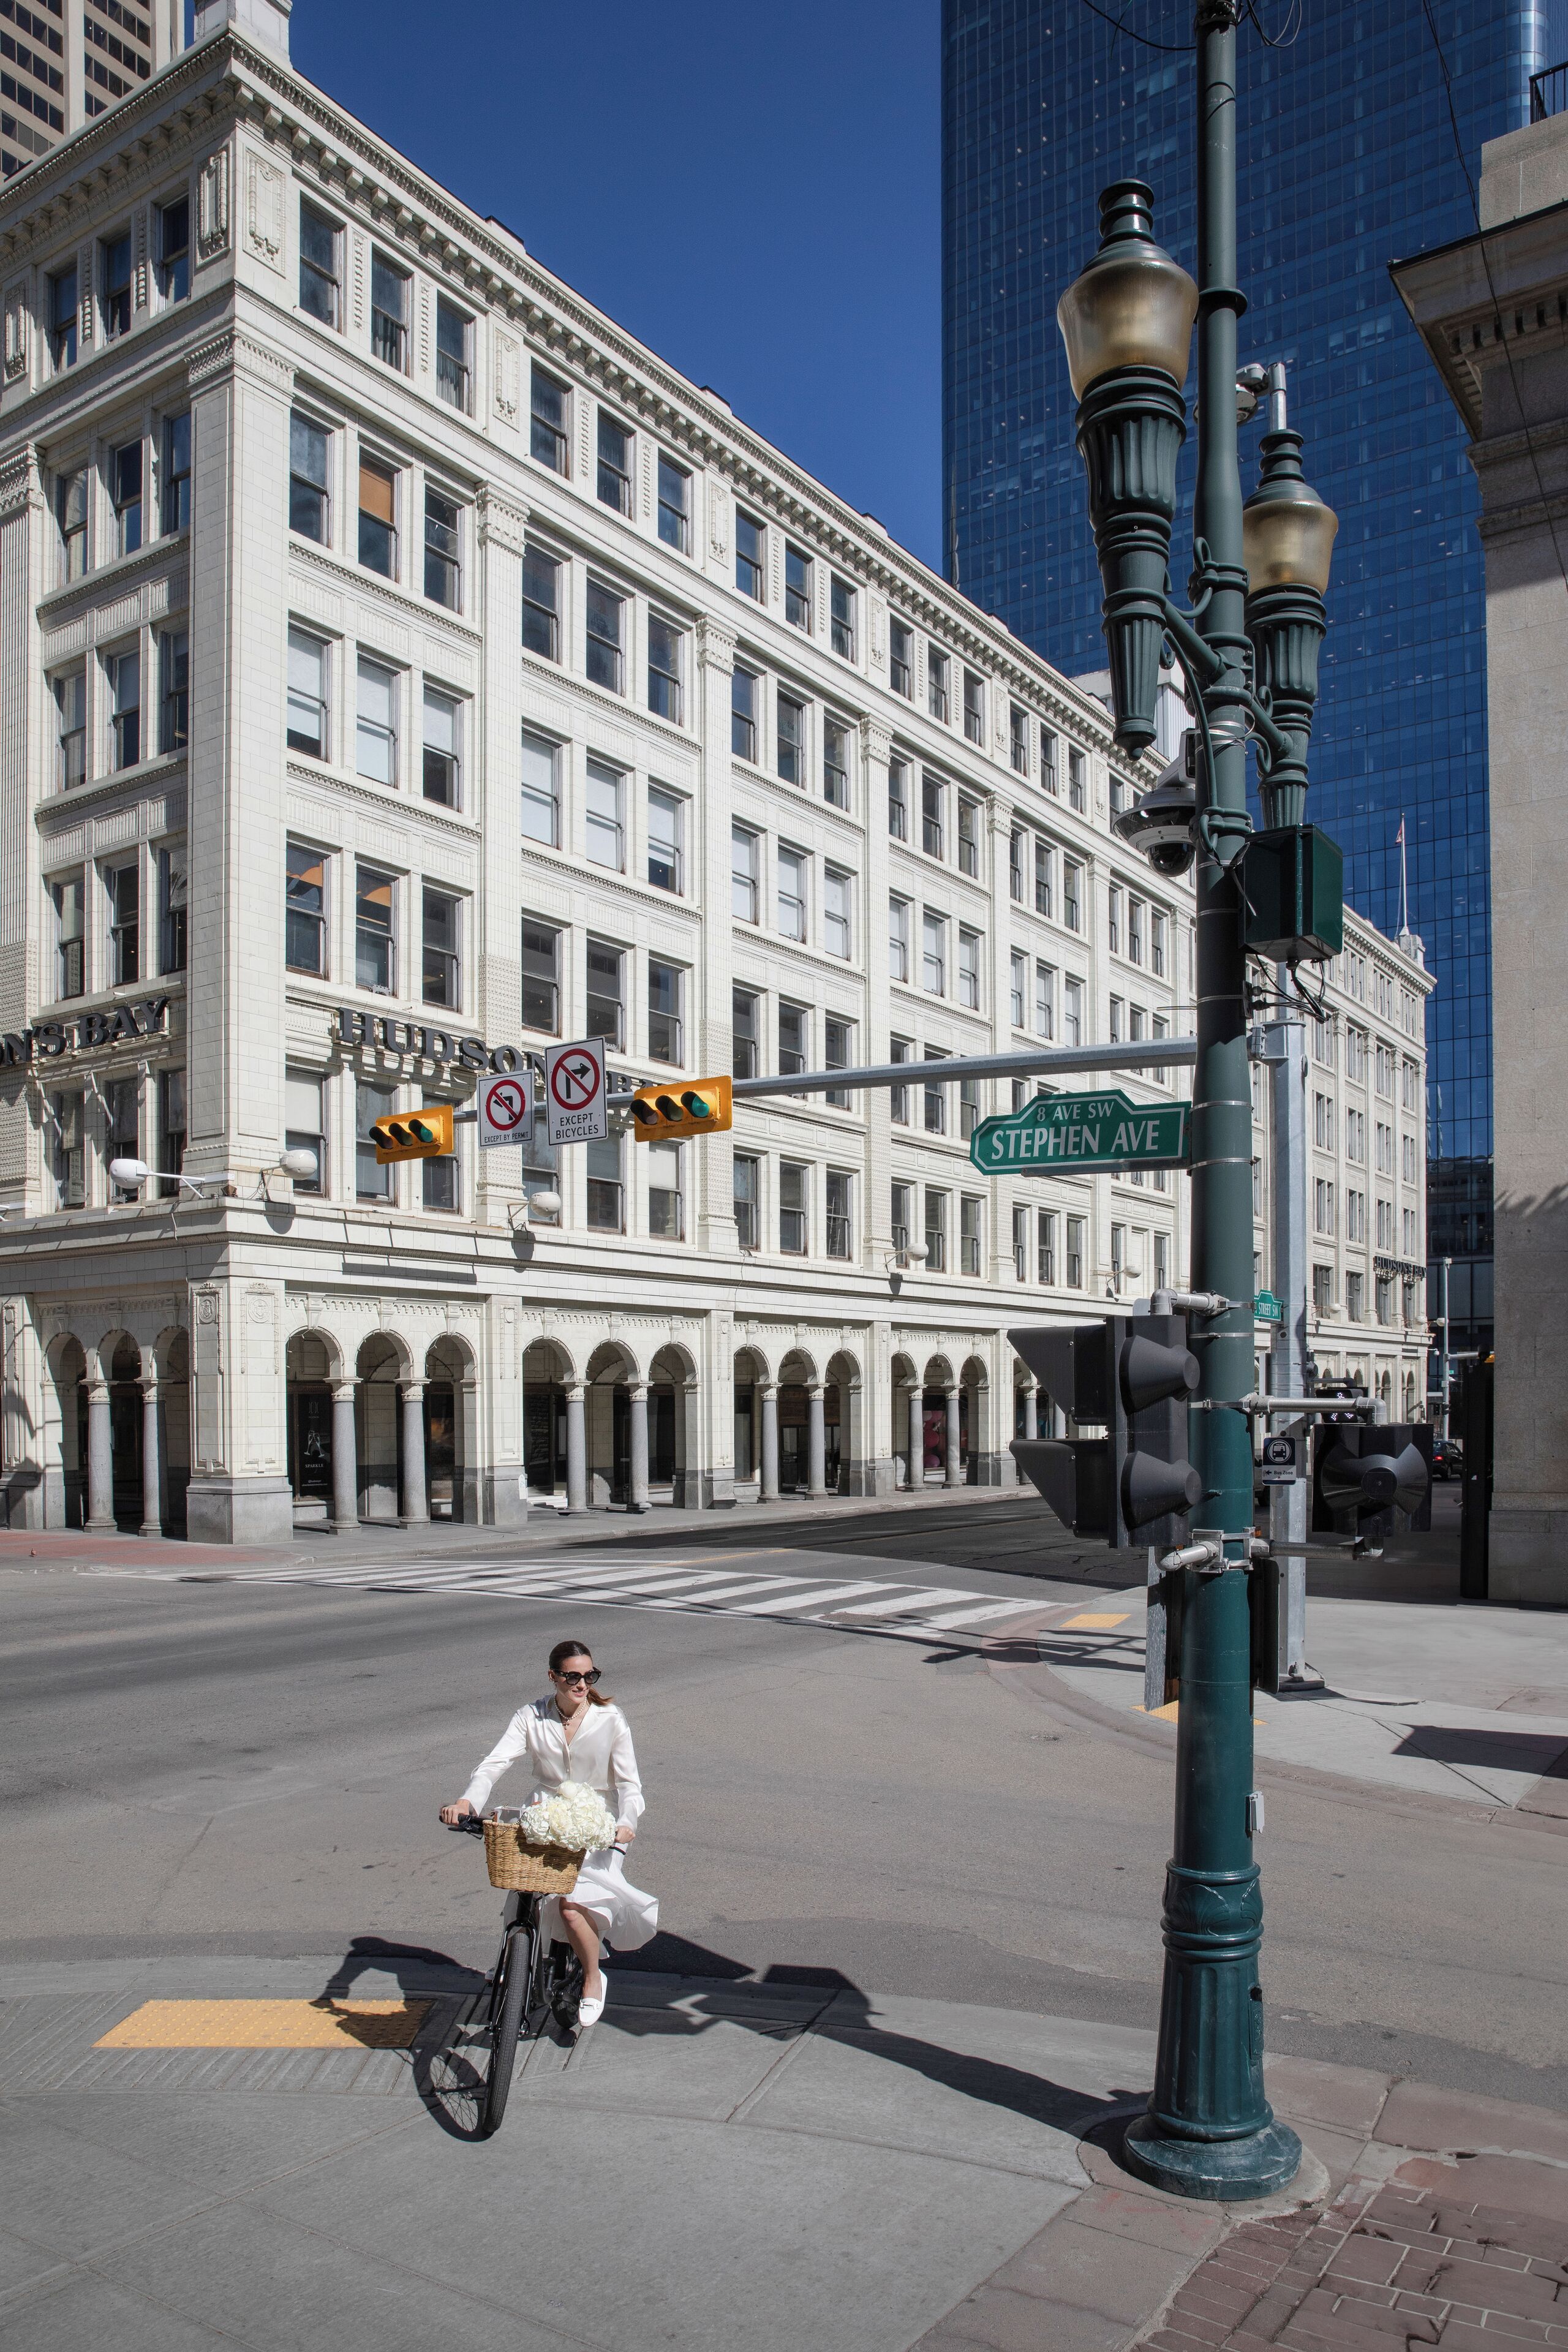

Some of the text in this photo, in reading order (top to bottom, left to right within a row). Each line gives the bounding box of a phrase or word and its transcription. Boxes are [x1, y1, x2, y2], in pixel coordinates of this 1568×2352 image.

[0, 996, 171, 1065] N'S BAY
[560, 1112, 594, 1126] EXCEPT
[1037, 1101, 1114, 1121] 8 AVE SW
[484, 1135, 502, 1144] EXCEPT
[512, 1131, 529, 1140] PERMIT
[556, 1124, 599, 1139] BICYCLES
[992, 1120, 1160, 1160] STEPHEN AVE
[1376, 1256, 1427, 1278] HUDSON'S BAY
[1259, 1302, 1271, 1316] STREET
[1272, 1305, 1279, 1316] SW
